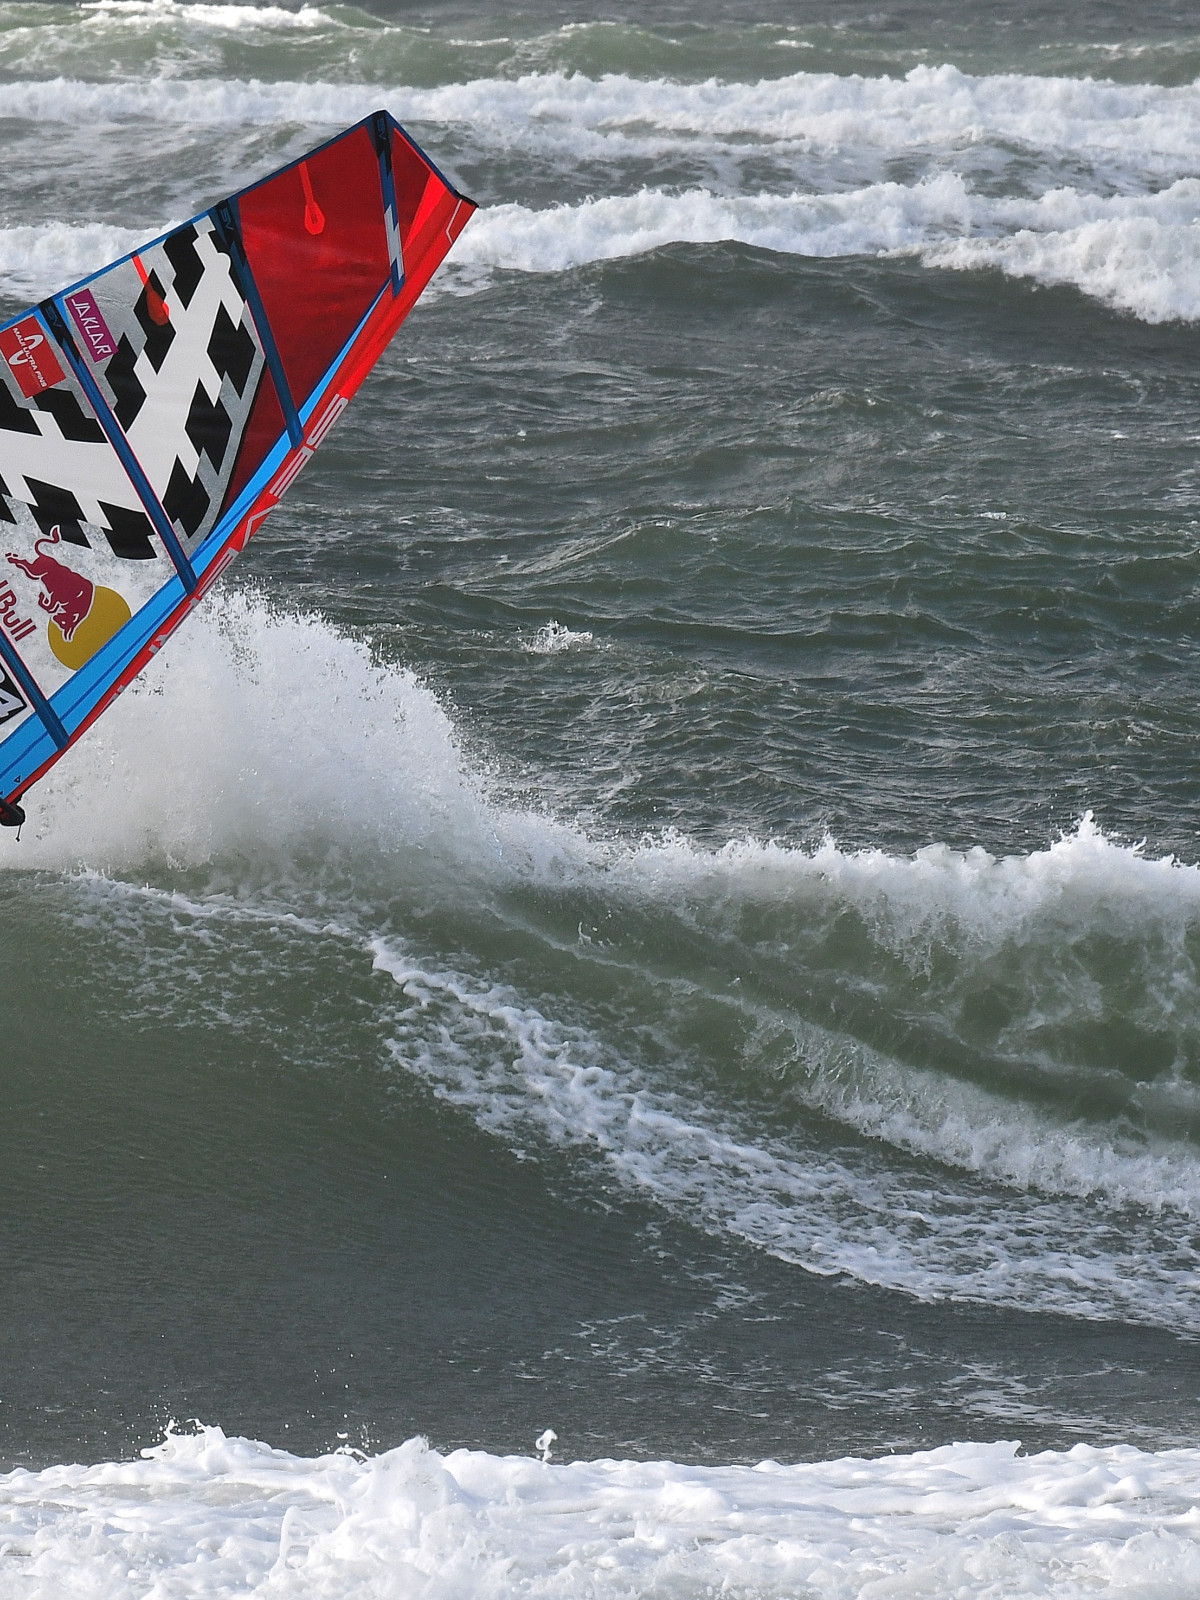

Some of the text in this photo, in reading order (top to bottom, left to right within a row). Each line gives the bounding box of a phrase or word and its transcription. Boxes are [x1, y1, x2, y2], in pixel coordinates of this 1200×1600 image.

[71, 298, 112, 355] JAKLAR
[13, 327, 26, 347] MAUI
[22, 346, 38, 371] ULTRA
[35, 370, 48, 388] FINS
